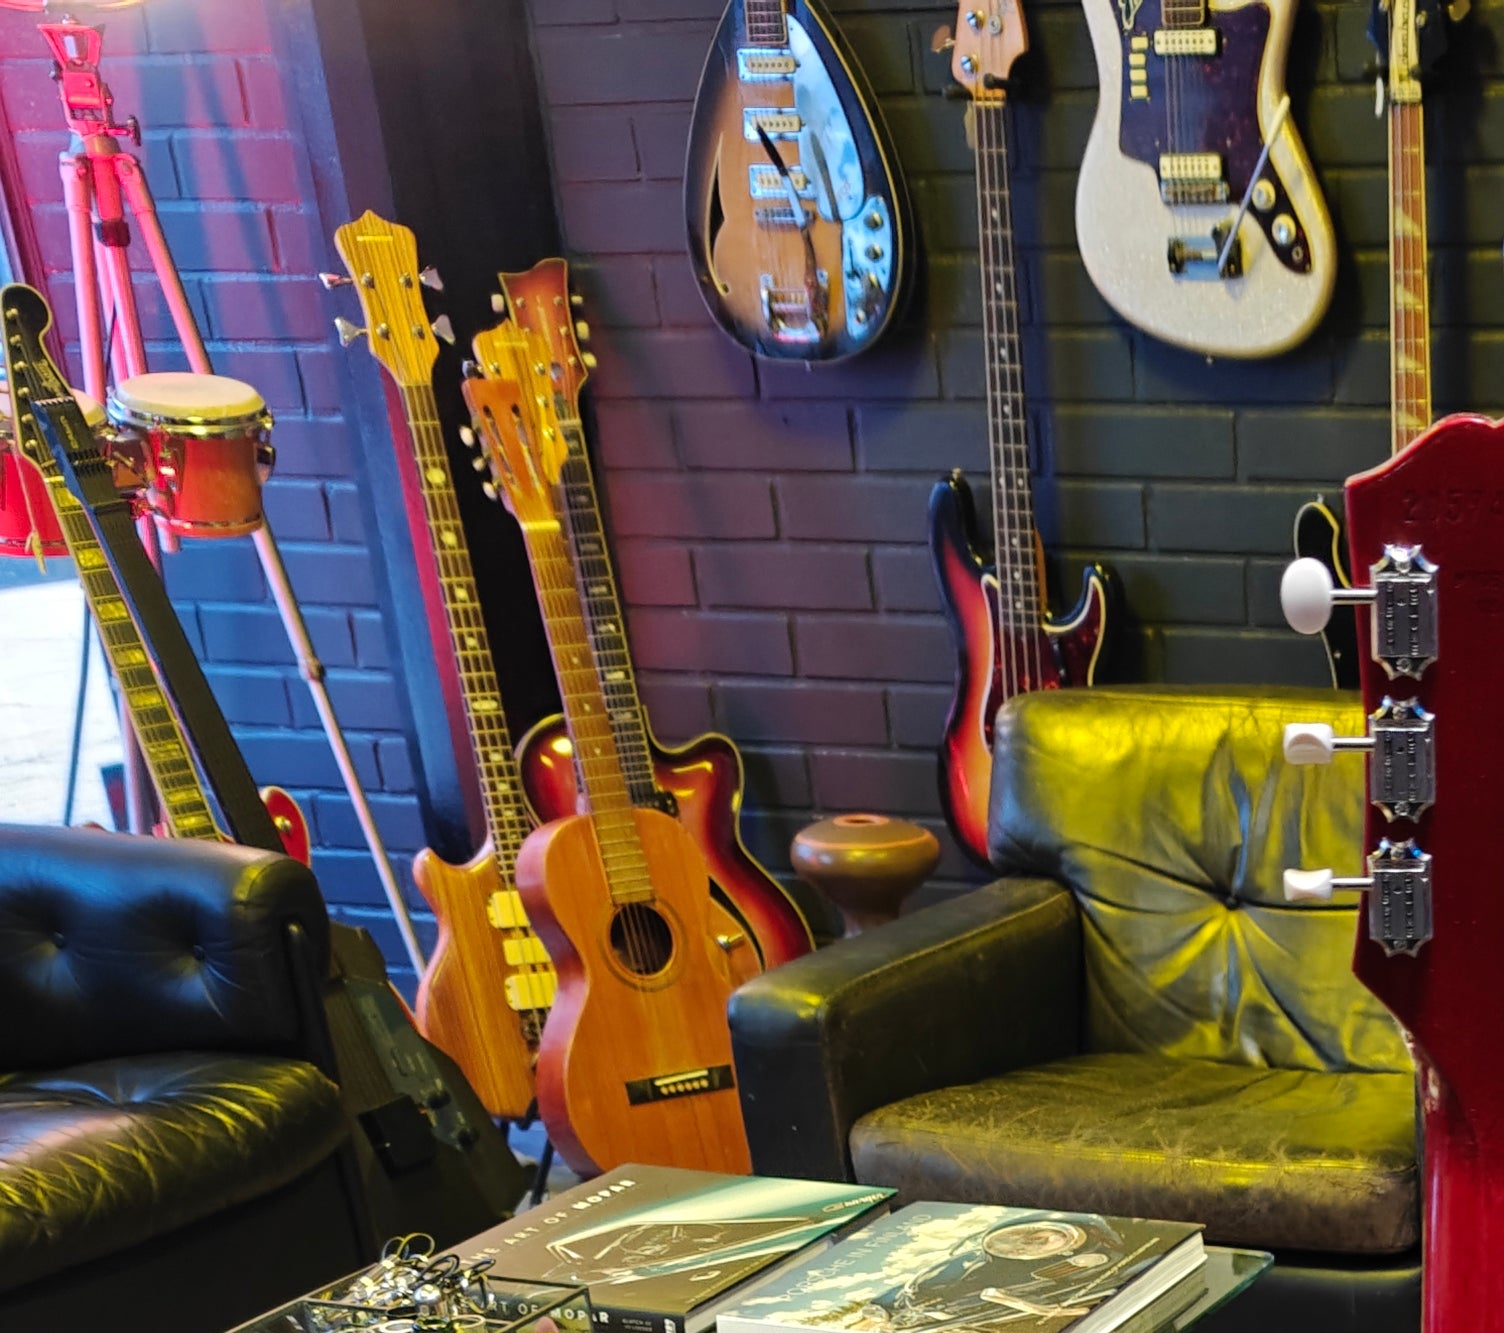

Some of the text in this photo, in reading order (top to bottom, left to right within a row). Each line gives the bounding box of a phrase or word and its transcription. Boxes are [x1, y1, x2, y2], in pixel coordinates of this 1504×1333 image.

[503, 1226, 540, 1246] ART
[543, 1211, 568, 1225] OF
[572, 1179, 636, 1210] MOPAR
[777, 1258, 856, 1302] PORSCHE
[864, 1214, 931, 1248] FINLAND
[518, 1303, 539, 1315] OF
